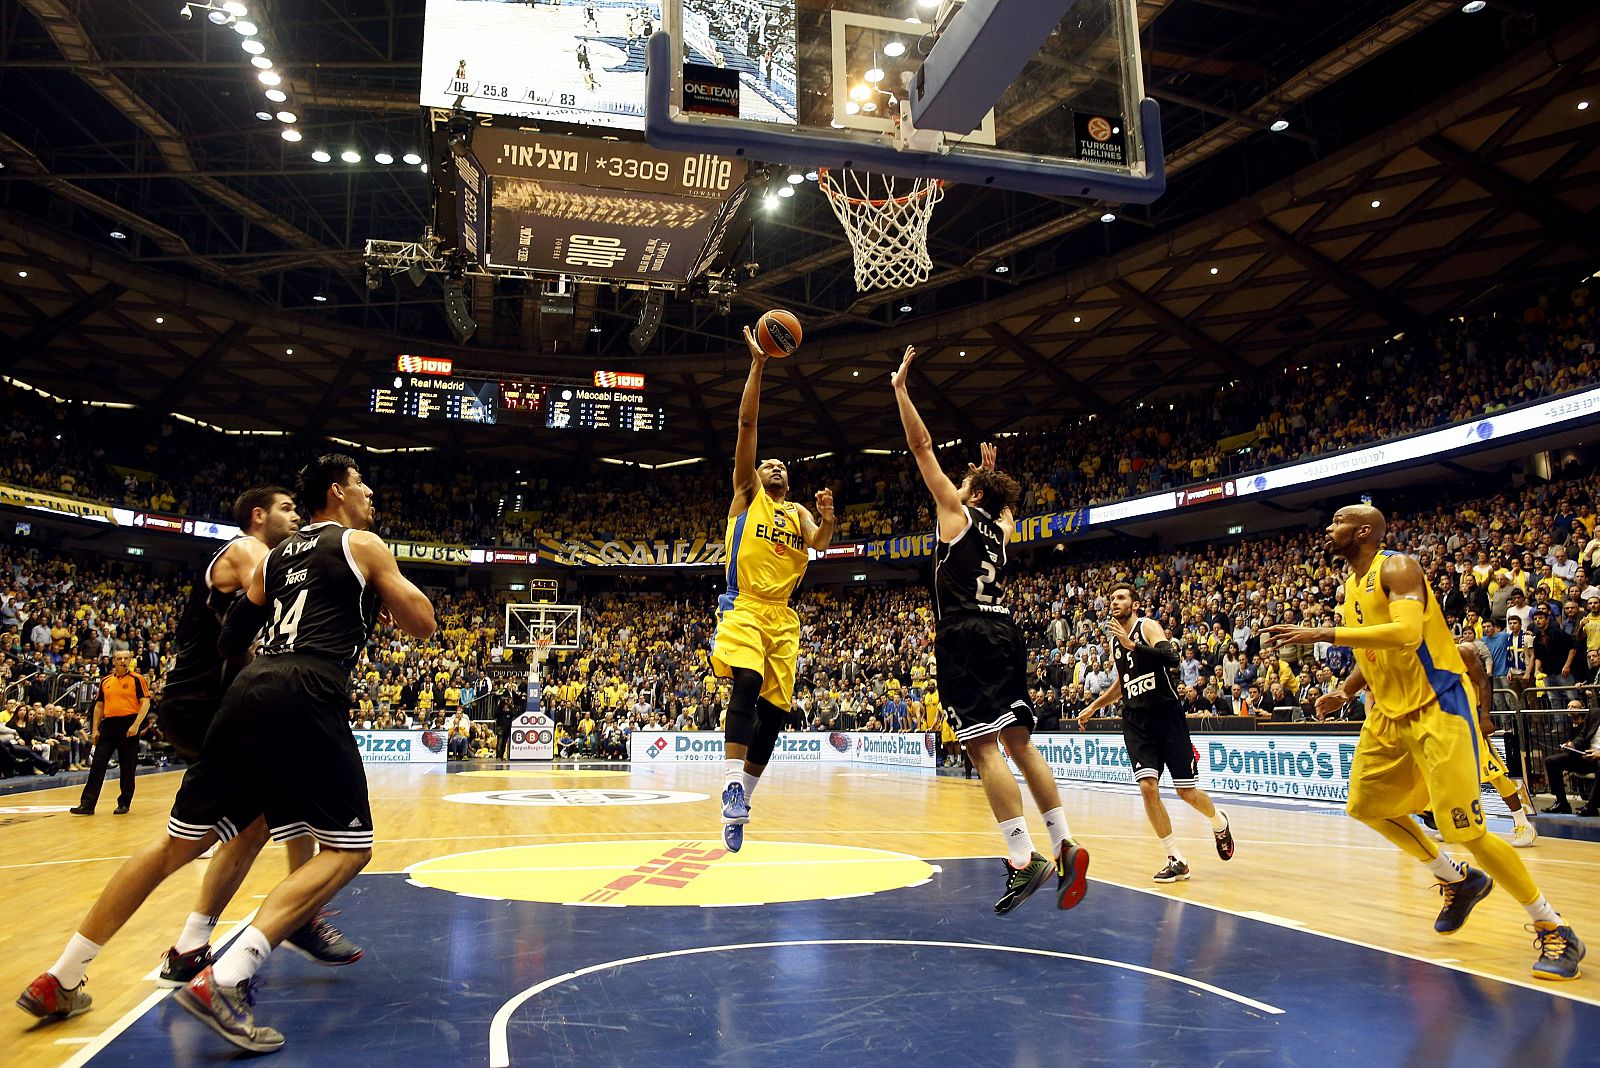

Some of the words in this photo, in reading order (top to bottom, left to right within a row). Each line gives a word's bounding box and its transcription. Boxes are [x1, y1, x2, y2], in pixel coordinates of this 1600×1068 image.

[483, 84, 508, 98] 25.8
[560, 94, 576, 106] 83
[684, 82, 706, 95] ONE
[710, 86, 738, 99] TEAM
[1080, 139, 1121, 152] TURKISH
[1081, 147, 1122, 160] AIRLINES
[682, 153, 732, 191] elite
[565, 234, 627, 268] elite
[410, 377, 431, 389] Real
[433, 379, 465, 391] Madrid
[576, 389, 612, 401] Maccabi
[613, 392, 644, 404] Electra
[1224, 481, 1235, 496] 8
[1176, 491, 1186, 506] 7
[133, 513, 144, 527] 4
[755, 523, 804, 550] ELECTRA
[889, 533, 935, 559] LOVE
[1010, 512, 1057, 544] LIFE
[1063, 511, 1077, 532] 7
[600, 541, 690, 565] GATE
[265, 588, 309, 646] 14
[1126, 650, 1134, 669] 5
[863, 735, 897, 754] Domino's
[898, 735, 921, 755] Pizza
[1208, 740, 1334, 780] Domino's
[1210, 777, 1299, 796] 1-700-70-70-70
[1471, 799, 1484, 825] 9
